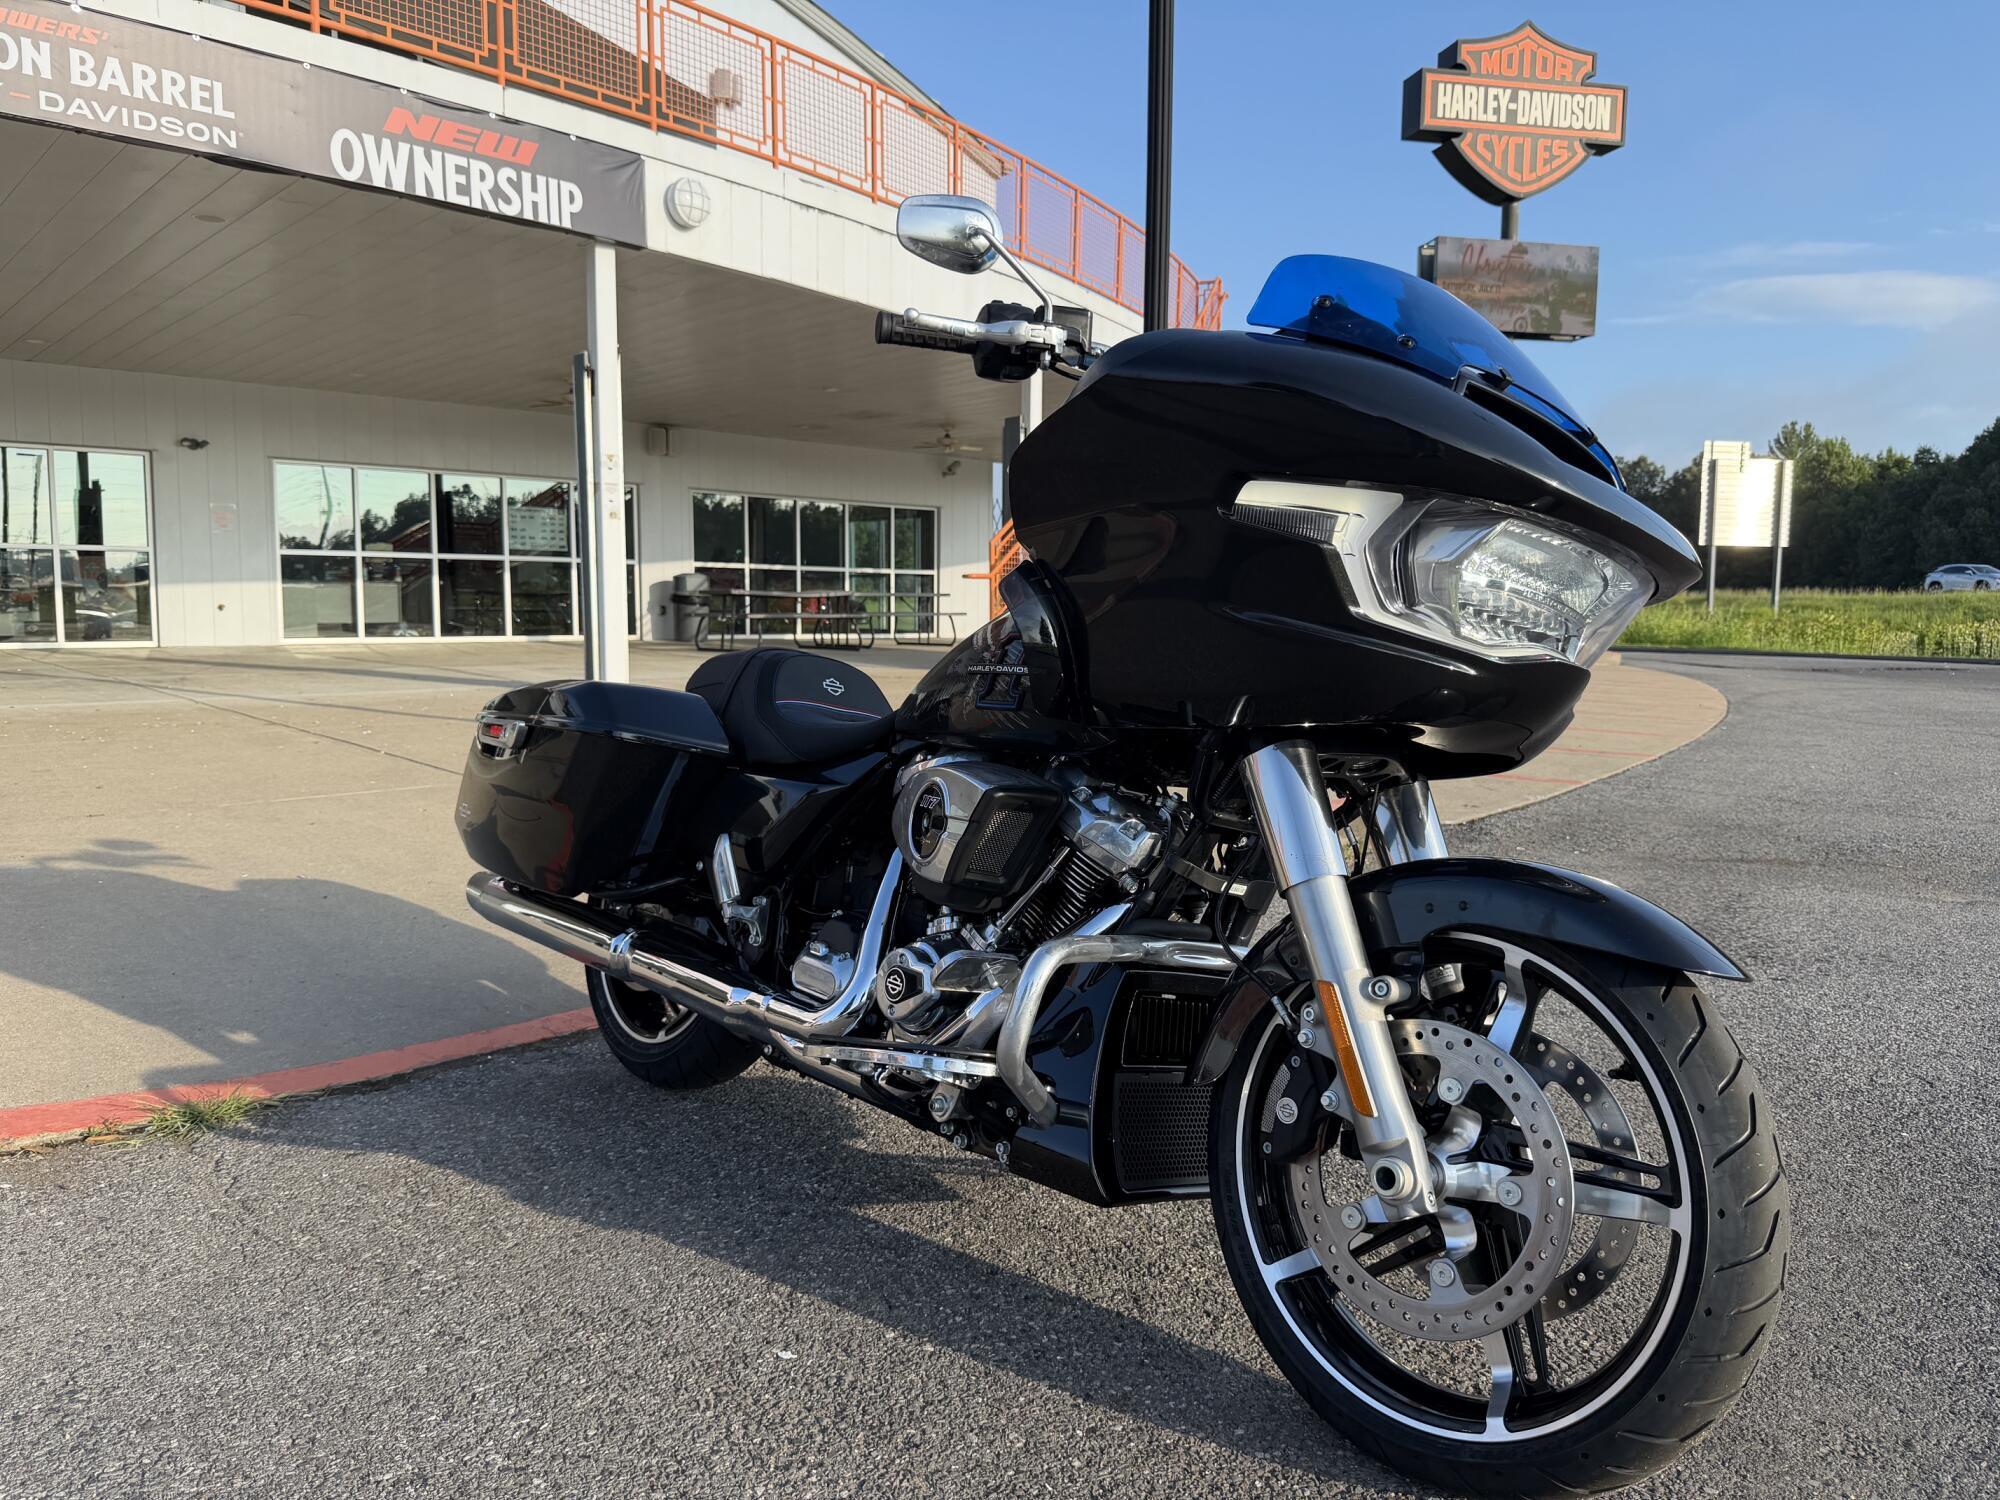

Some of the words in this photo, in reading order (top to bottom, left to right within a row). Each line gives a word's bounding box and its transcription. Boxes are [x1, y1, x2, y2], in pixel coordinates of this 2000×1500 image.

[69, 47, 235, 119] BARREL
[1480, 38, 1574, 82] MOTOR
[1437, 82, 1612, 131] HARLEY-DAVIDSON
[383, 107, 540, 166] NEW
[1476, 133, 1569, 182] CYCLES
[330, 128, 584, 229] OWNERSHIP
[920, 794, 941, 809] 117
